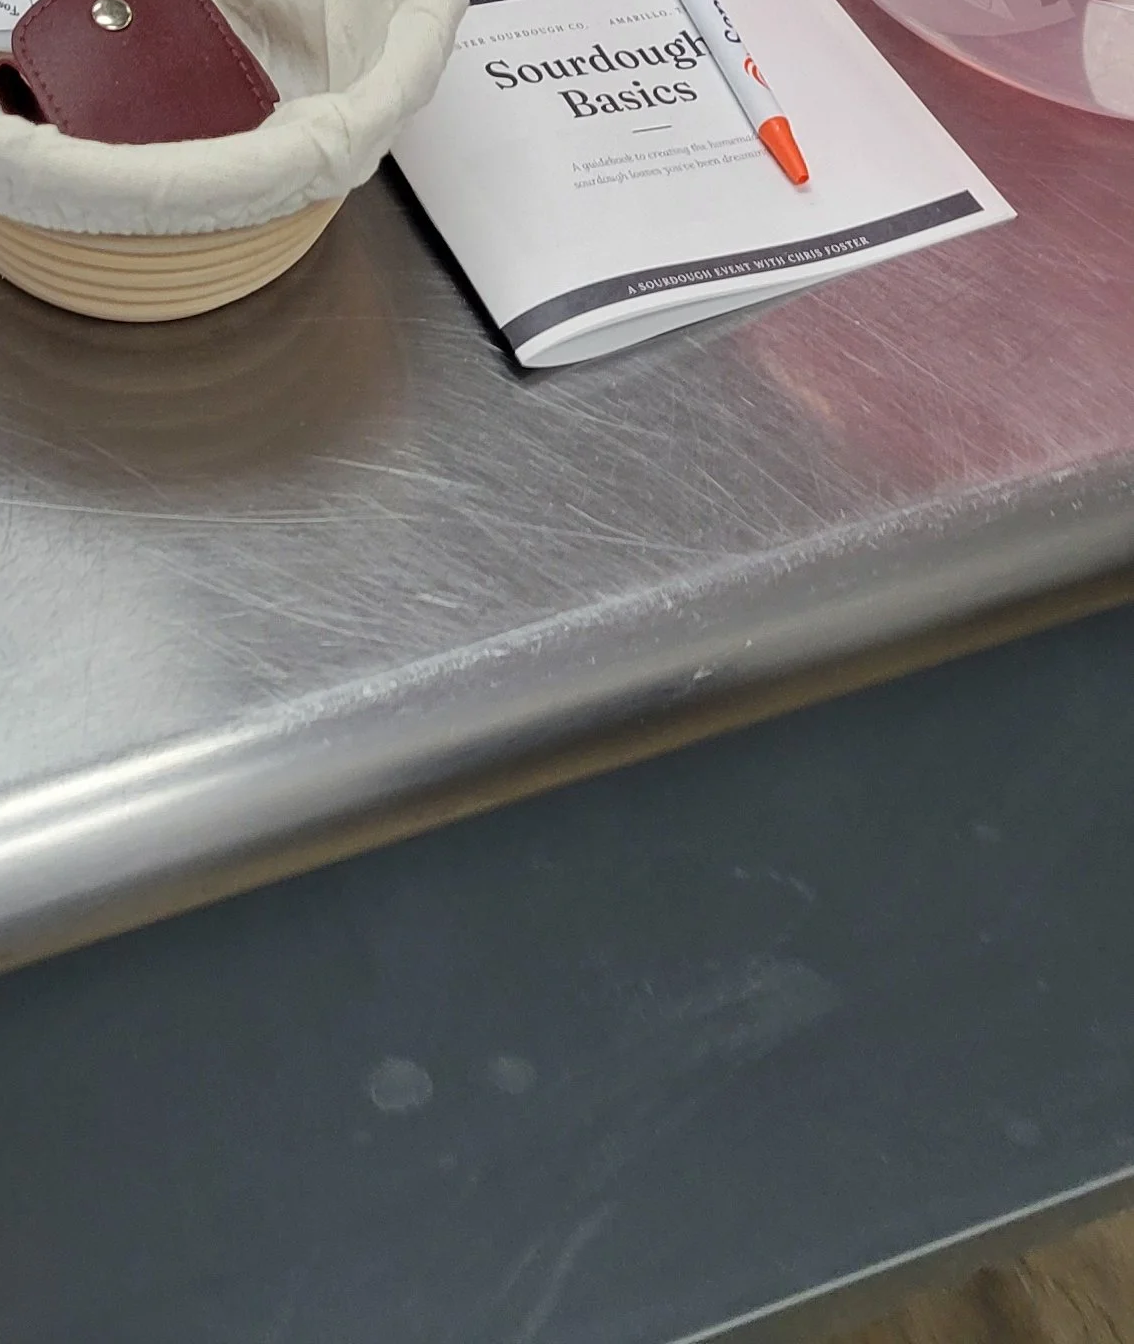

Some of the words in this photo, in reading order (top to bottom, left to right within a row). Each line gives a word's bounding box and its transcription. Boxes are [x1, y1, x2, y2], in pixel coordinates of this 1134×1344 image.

[454, 37, 485, 51] STER
[489, 24, 564, 43] SOURDOUGH
[485, 30, 709, 91] Sourdough
[558, 80, 698, 119] Basics
[572, 161, 582, 173] A
[582, 153, 634, 173] guidebook
[634, 152, 646, 161] to
[647, 145, 691, 160] creating
[691, 143, 707, 152] the
[574, 171, 629, 190] sourdough
[695, 157, 721, 169] been
[627, 285, 637, 295] A
[638, 269, 713, 292] SOURDOUGH
[714, 262, 751, 278] EVENT
[753, 255, 786, 270] WITH
[787, 248, 823, 263] CHRIS
[824, 236, 870, 256] FOSTER
